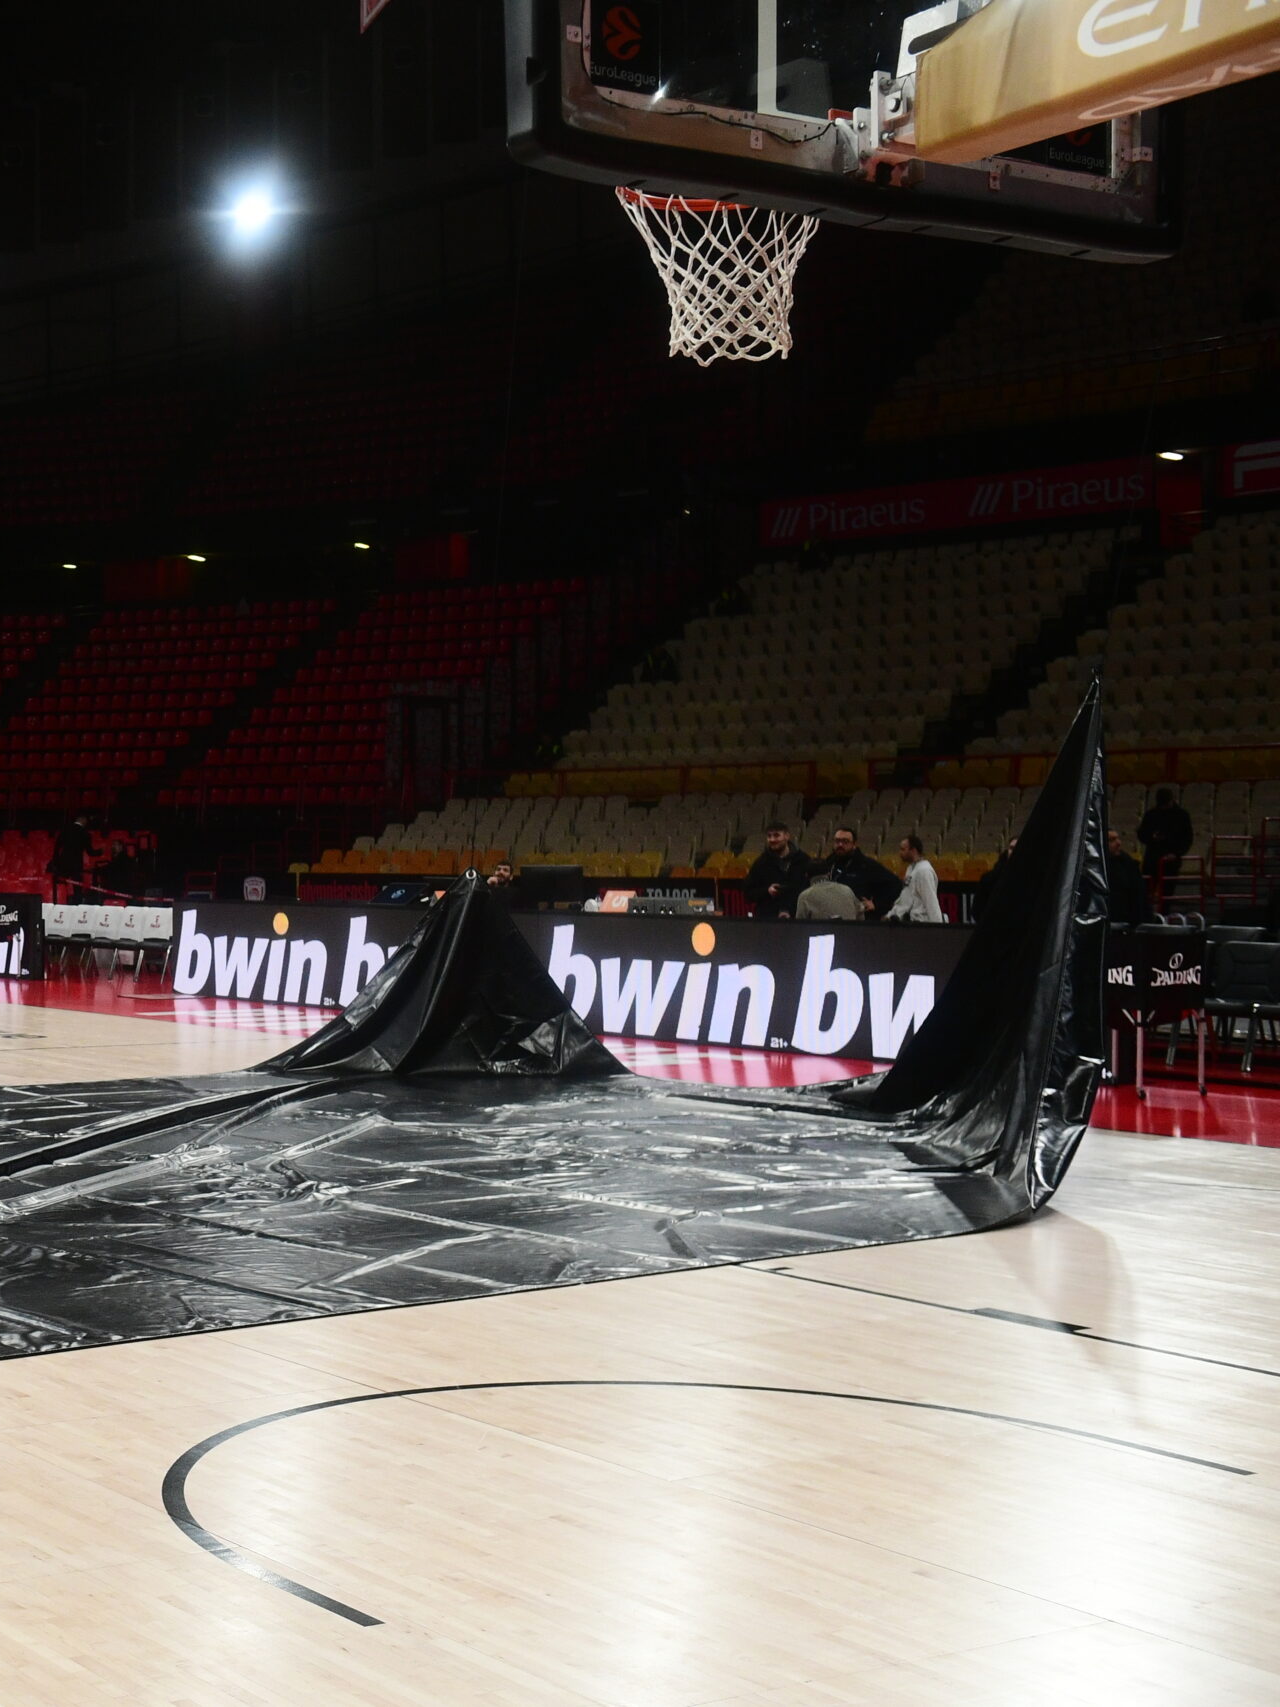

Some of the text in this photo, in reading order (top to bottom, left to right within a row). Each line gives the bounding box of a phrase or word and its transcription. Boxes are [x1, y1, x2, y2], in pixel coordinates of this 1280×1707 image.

[1049, 144, 1105, 169] EuroLeague
[1009, 470, 1145, 514] Piraeus
[807, 497, 926, 534] Piraeus
[173, 909, 327, 1006] bwin
[1151, 965, 1202, 987] SPALDING
[548, 921, 776, 1047] bwin
